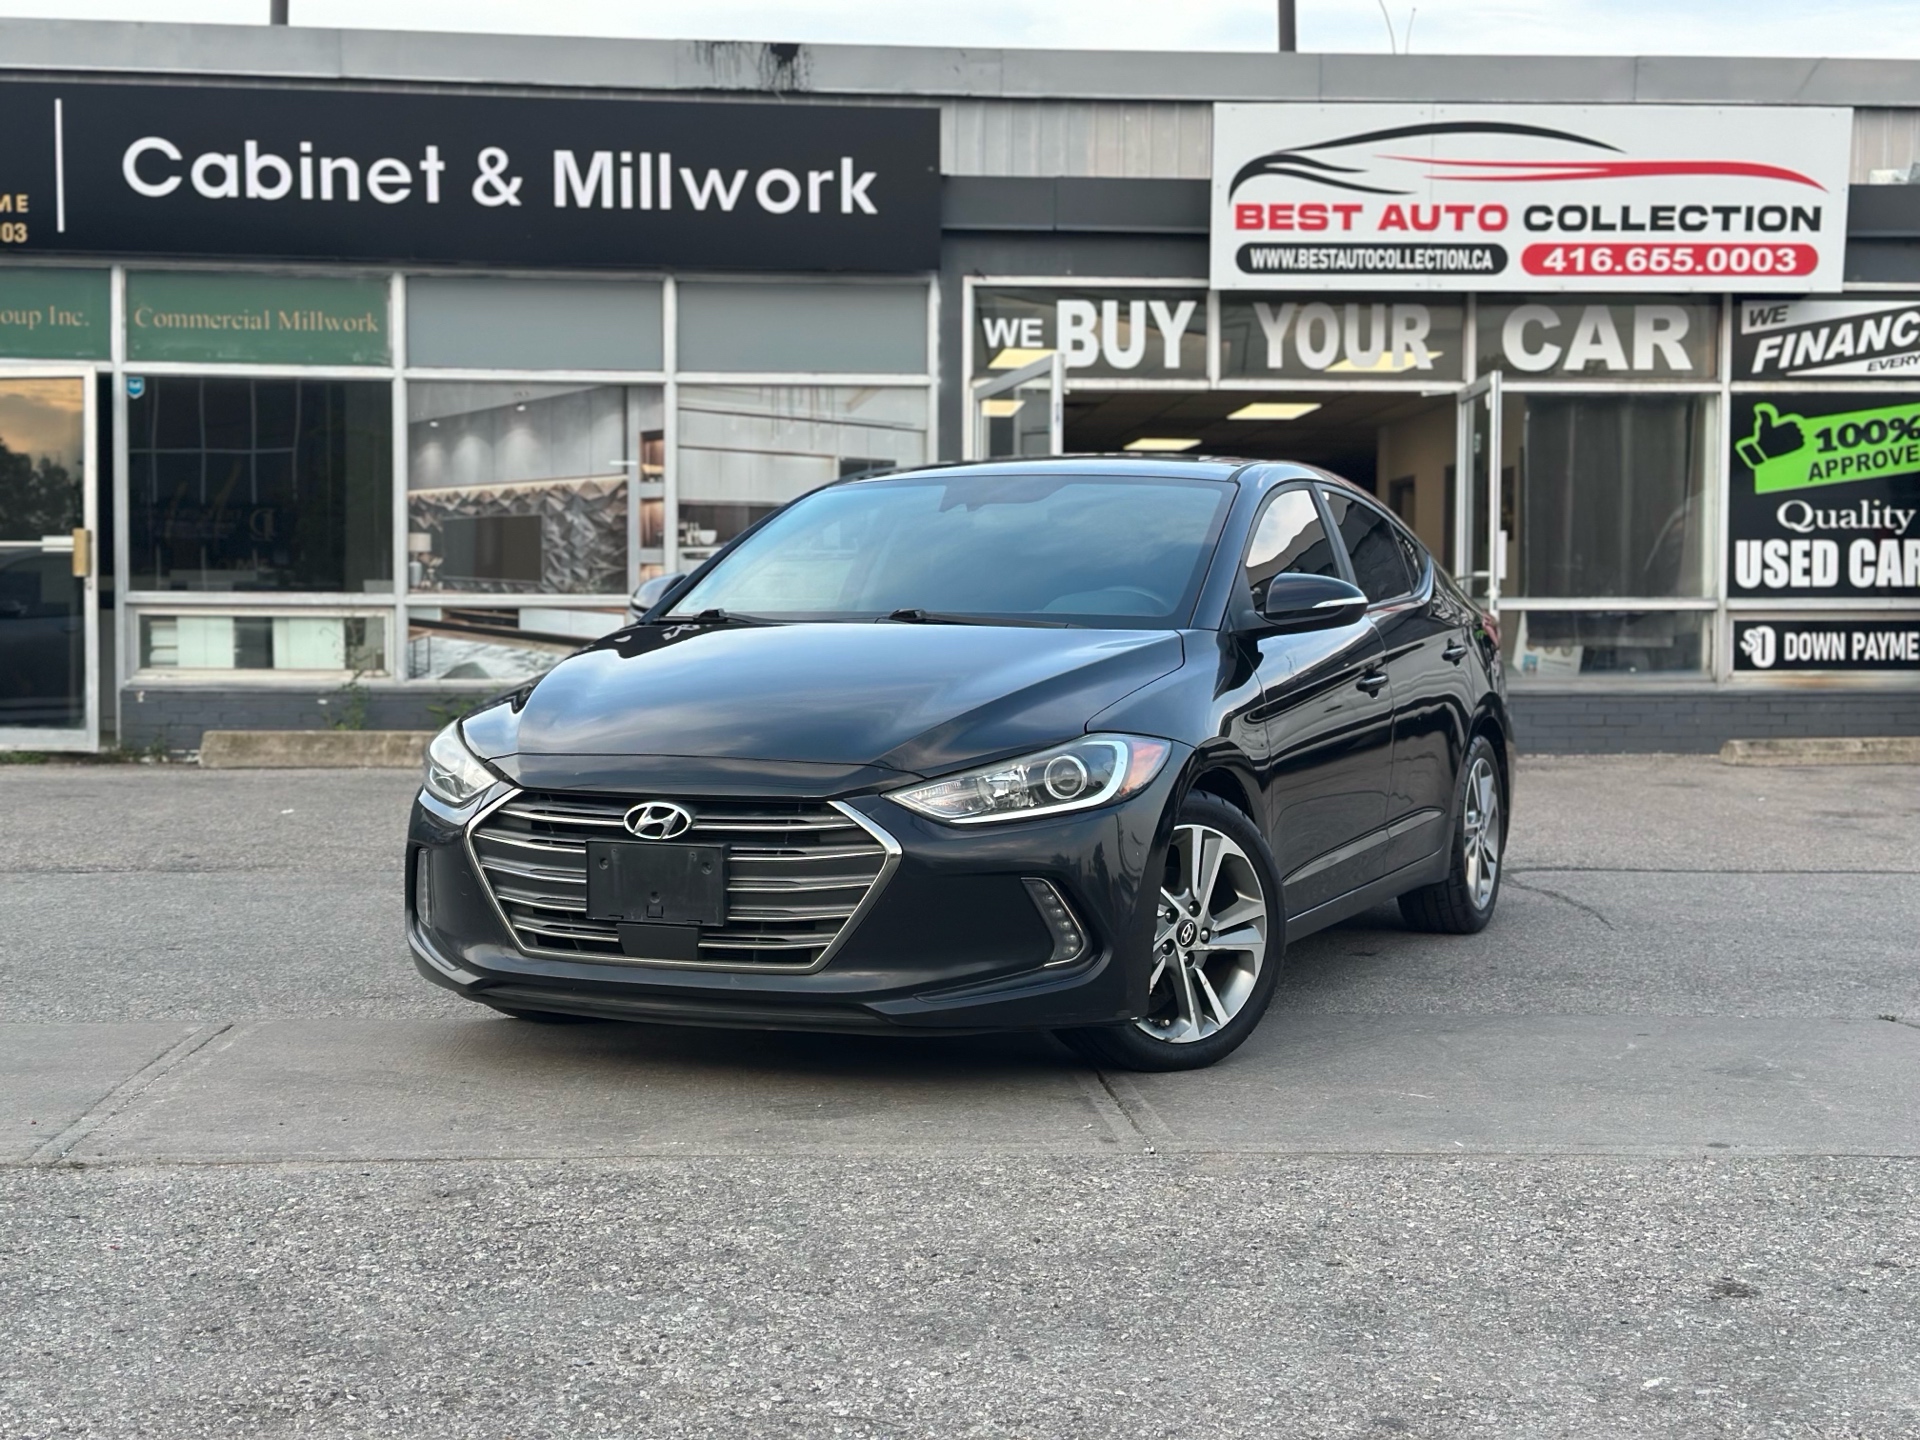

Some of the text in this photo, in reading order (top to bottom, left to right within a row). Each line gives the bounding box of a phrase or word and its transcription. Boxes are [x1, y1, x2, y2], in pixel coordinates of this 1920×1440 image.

[122, 136, 878, 215] Cabinet & Millwork
[0, 222, 28, 243] 03
[1235, 204, 1822, 232] BEST AUTO COLLECTION
[1250, 248, 1494, 270] WWW.BESTAUTOCOLLECTION.CA
[1542, 247, 1798, 273] 416.655.0003
[49, 305, 90, 327] Inc.
[134, 307, 379, 332] Commercial Millwork
[1748, 305, 1789, 328] WE
[982, 300, 1694, 371] WE BUY YOUR CAR
[1751, 310, 1920, 374] FINANC
[1814, 414, 1920, 453] 100%
[1808, 444, 1919, 481] APPROVE
[1776, 499, 1917, 536] Quality
[1735, 539, 1920, 589] USED CAR
[1784, 632, 1846, 662] DOWN
[1852, 632, 1920, 662] PAYME
